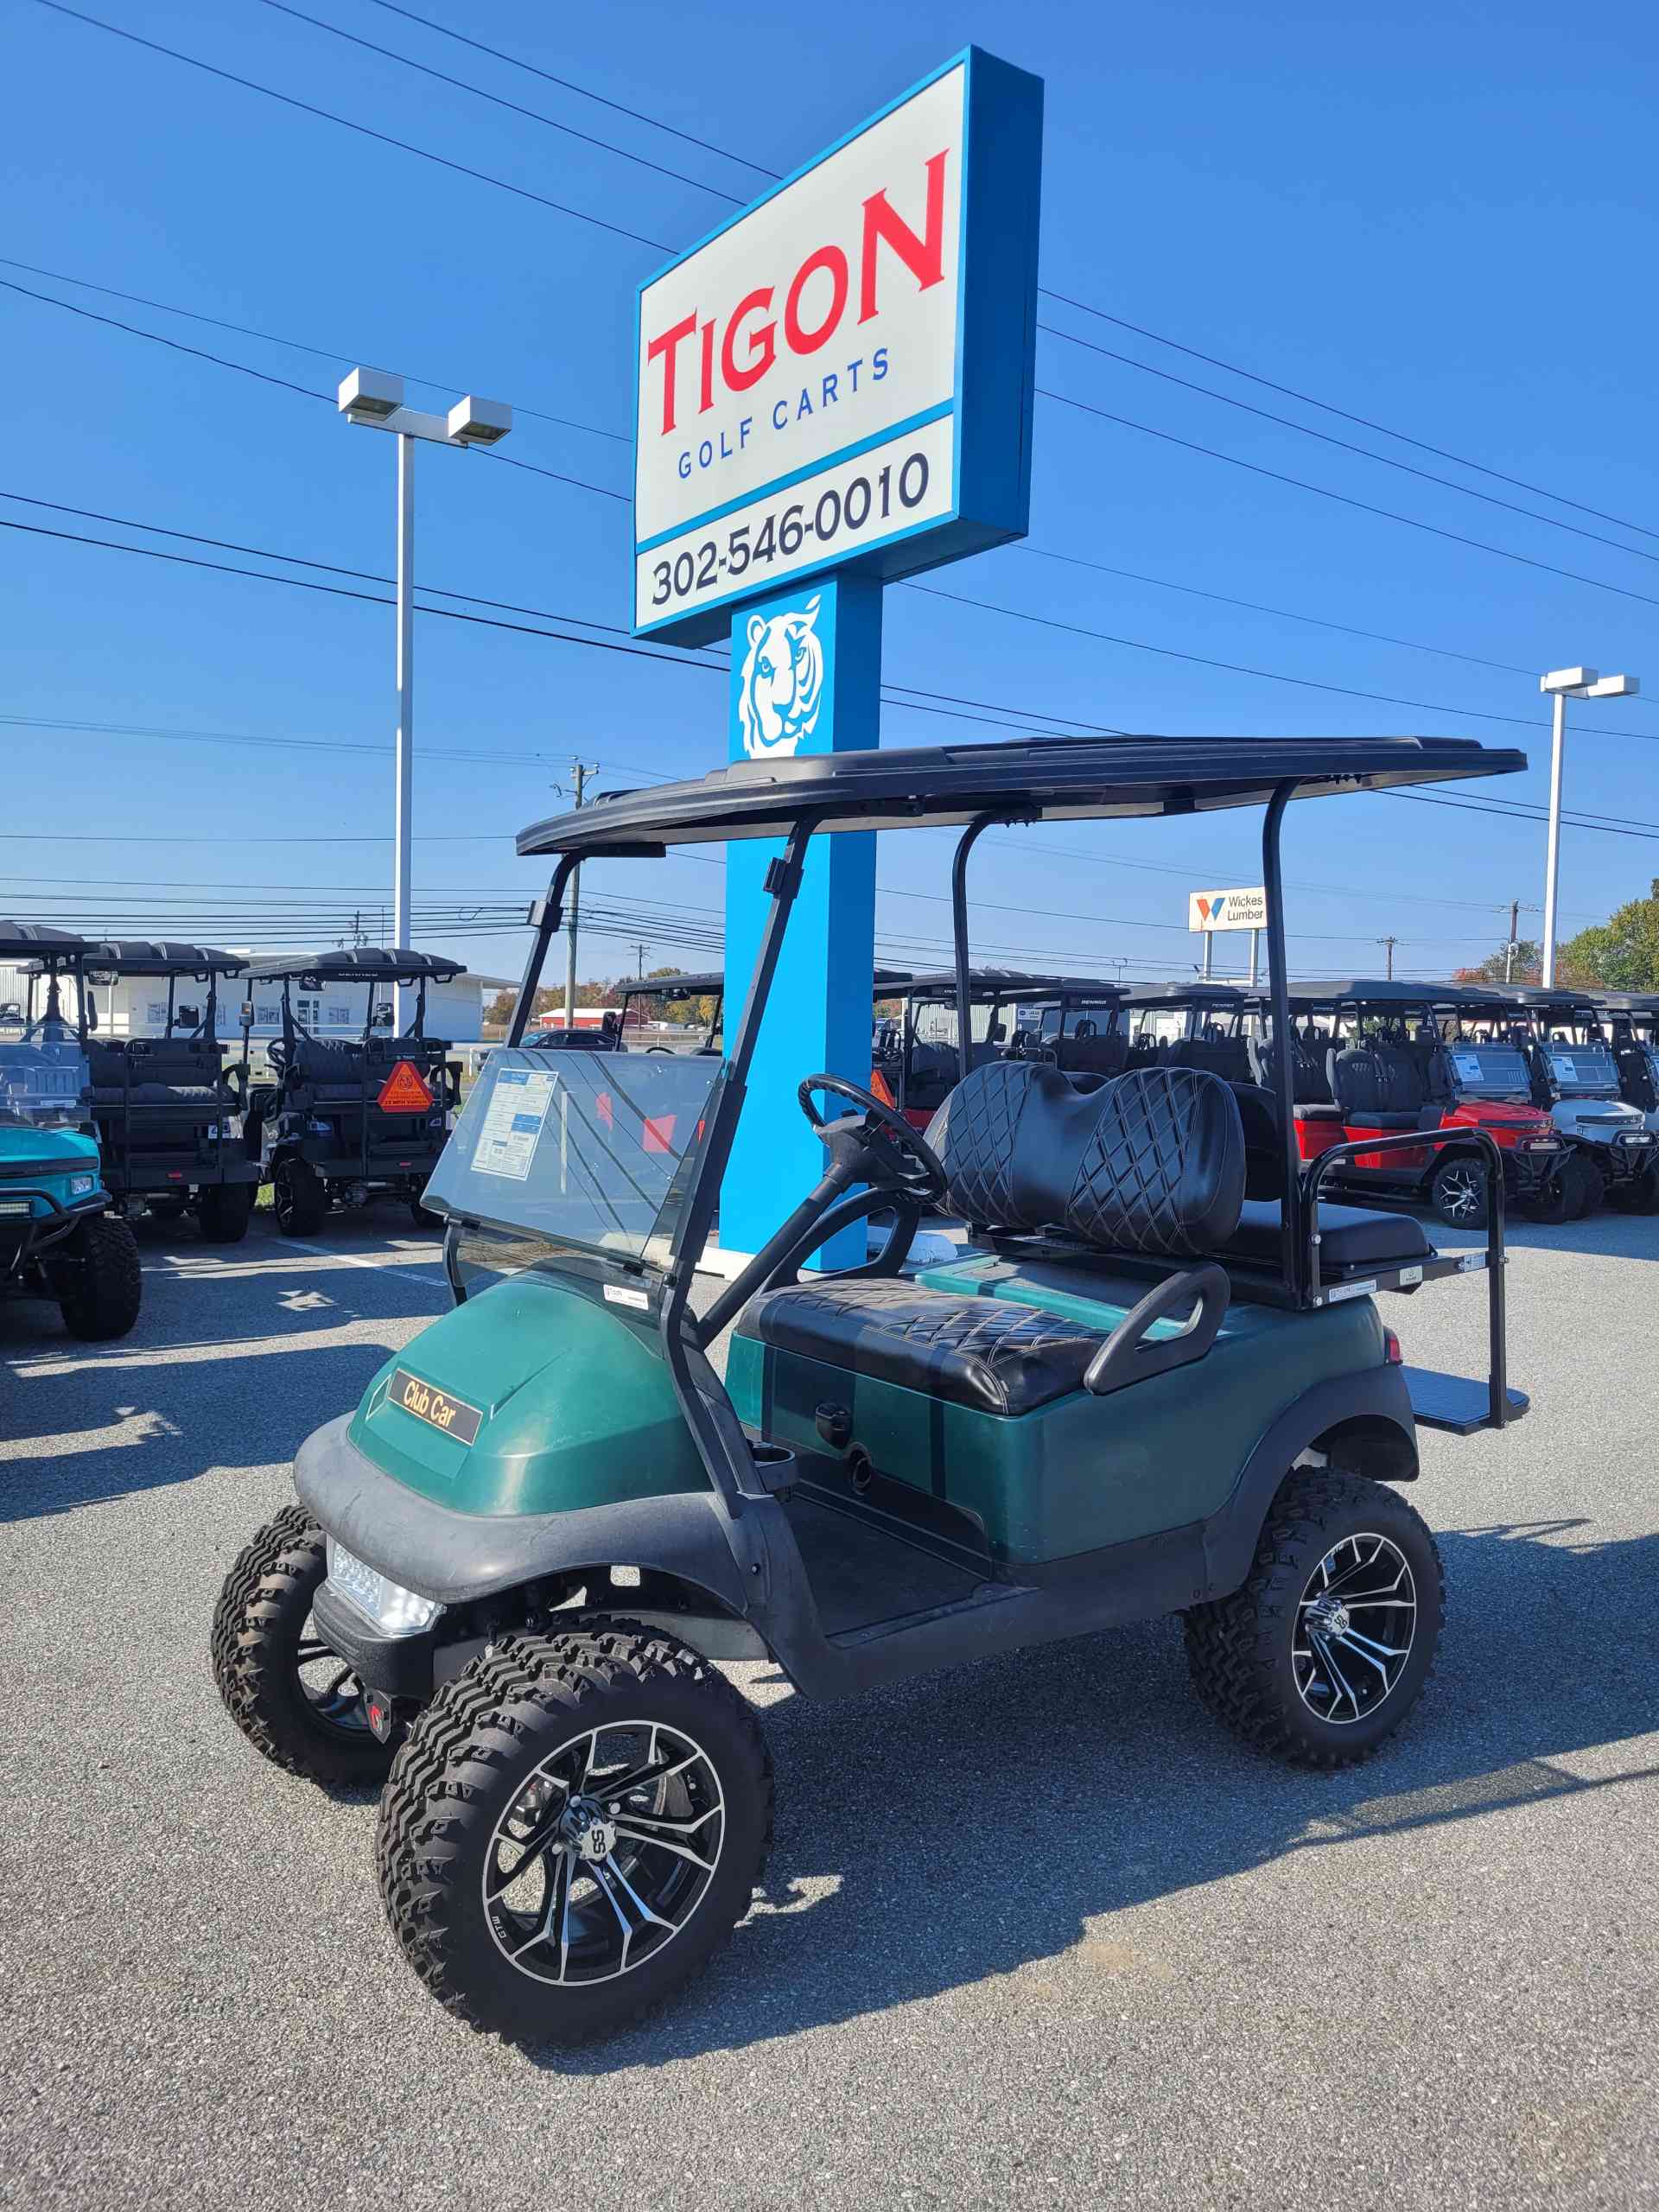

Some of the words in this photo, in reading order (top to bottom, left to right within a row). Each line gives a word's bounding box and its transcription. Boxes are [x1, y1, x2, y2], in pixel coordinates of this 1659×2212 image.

[647, 148, 951, 435] TIGON
[678, 416, 753, 479] GOLF
[772, 347, 888, 429] CARTS
[652, 452, 929, 605] 302-546-0010
[1227, 910, 1263, 921] Lumber
[1228, 896, 1263, 907] Wickes
[404, 1381, 429, 1414] Club
[430, 1395, 456, 1427] Car
